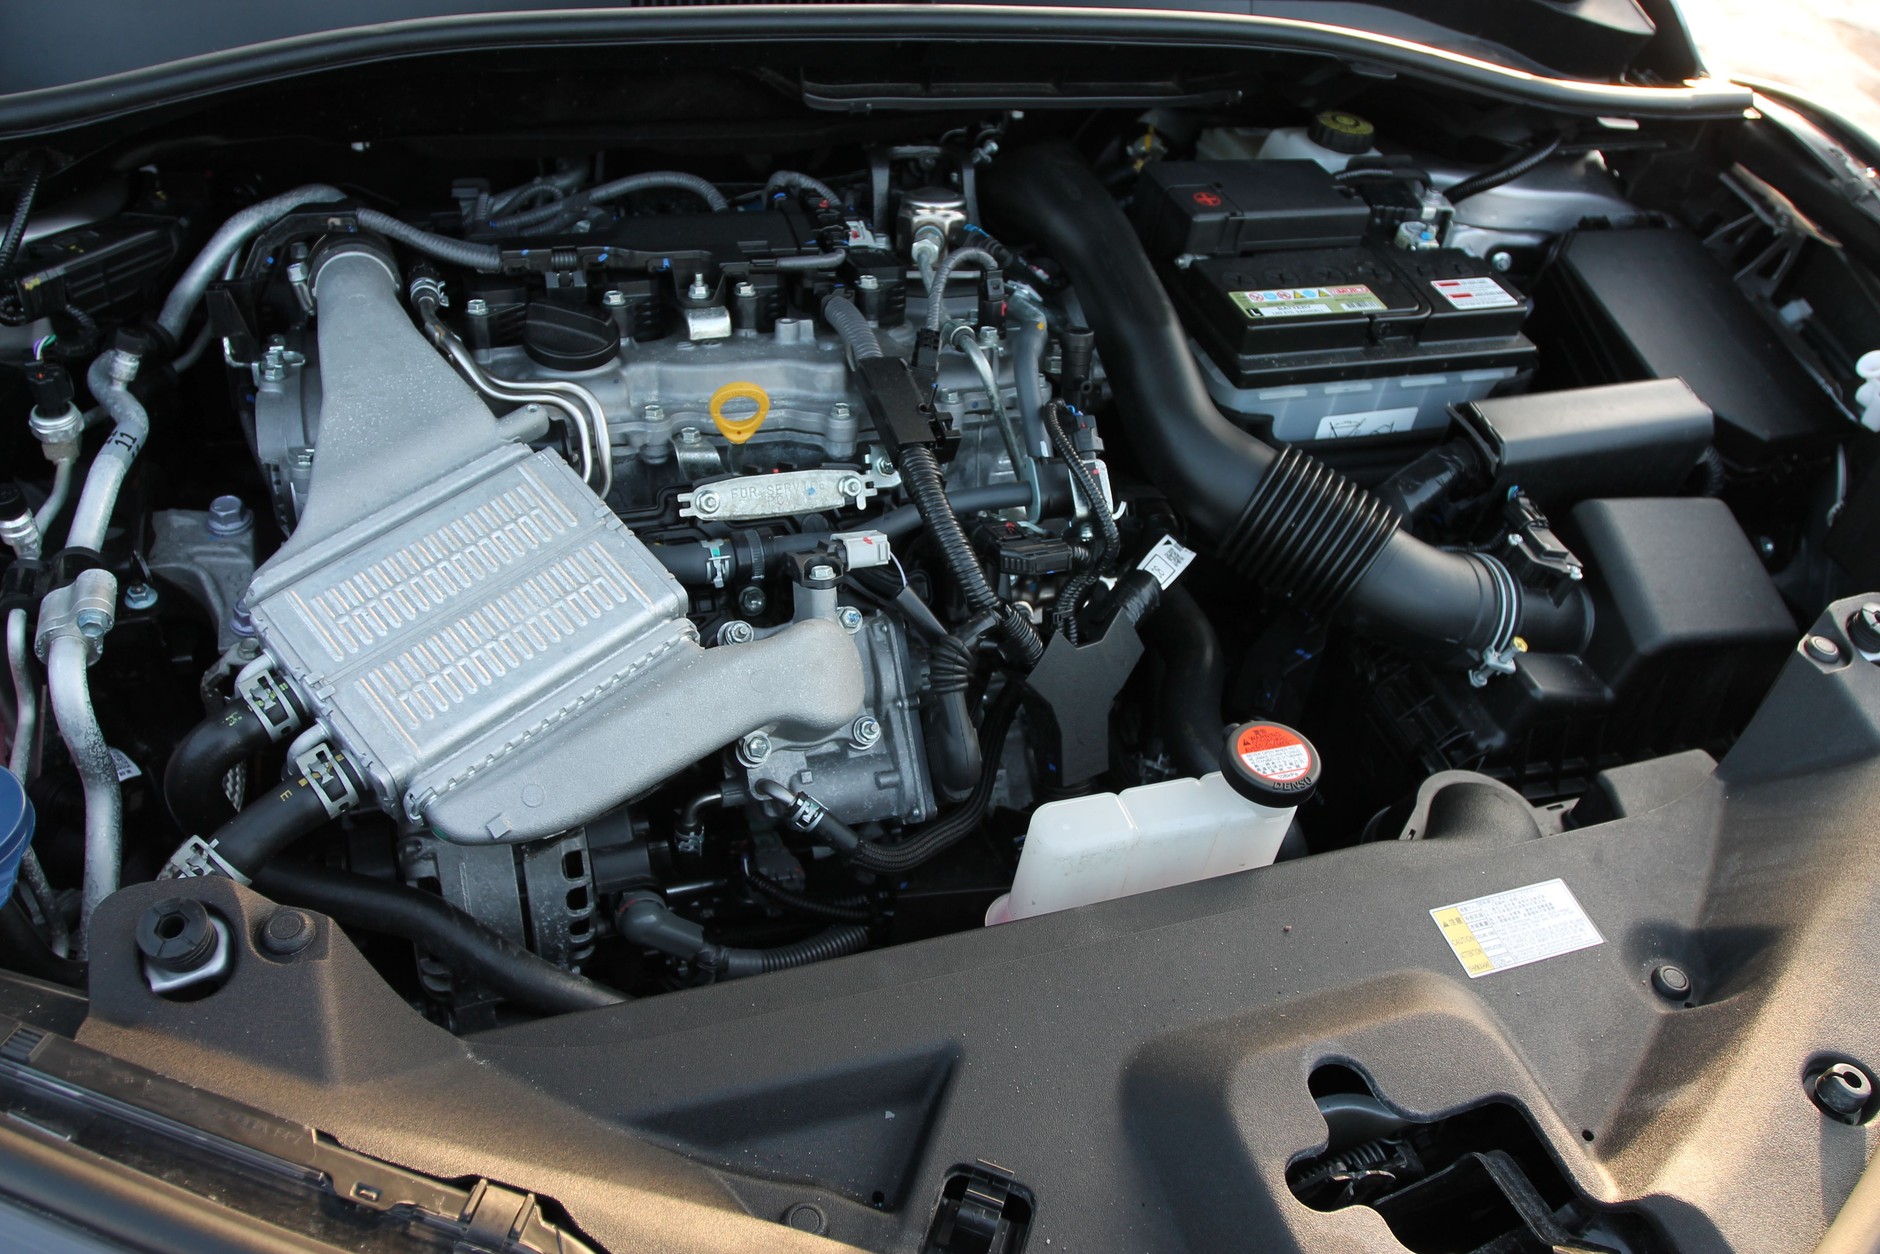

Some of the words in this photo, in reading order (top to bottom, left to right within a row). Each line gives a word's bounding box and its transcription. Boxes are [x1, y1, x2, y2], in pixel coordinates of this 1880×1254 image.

[114, 432, 137, 451] 11
[731, 486, 758, 500] FOR
[1272, 776, 1313, 792] DENSO
[1451, 934, 1475, 947] CAUTION
